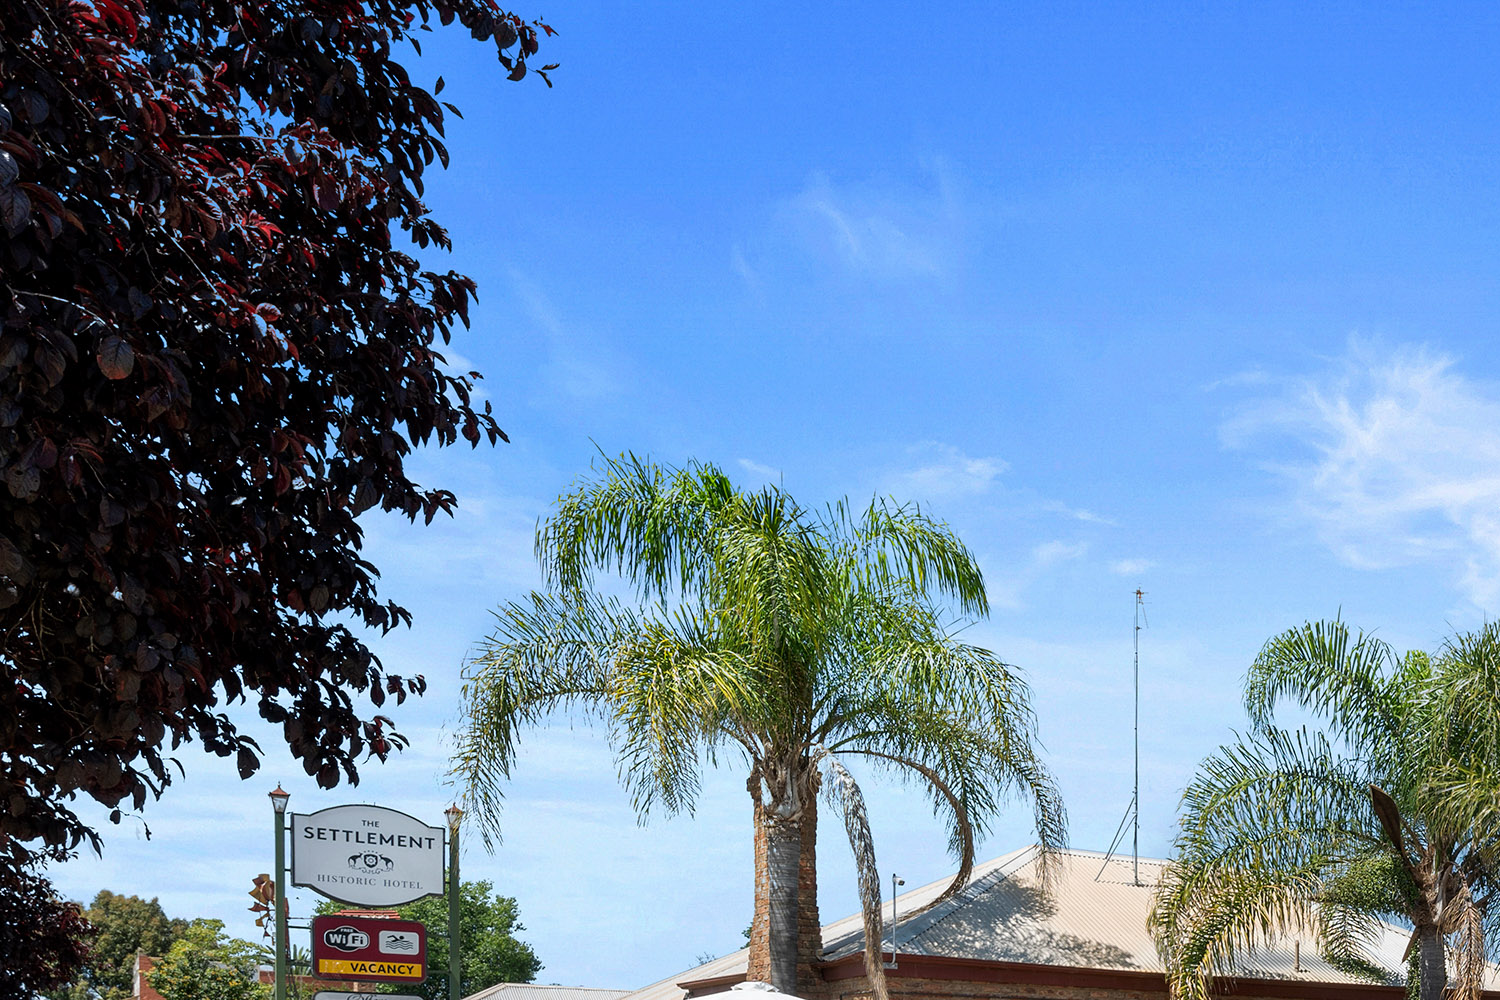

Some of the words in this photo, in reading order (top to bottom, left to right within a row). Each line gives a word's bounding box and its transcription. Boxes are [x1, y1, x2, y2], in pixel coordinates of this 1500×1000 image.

[361, 819, 380, 828] THE
[304, 826, 435, 850] SETTLEMENT
[317, 874, 376, 886] HISTORIC
[383, 879, 423, 890] HOTEL
[350, 962, 415, 975] VACANCY
